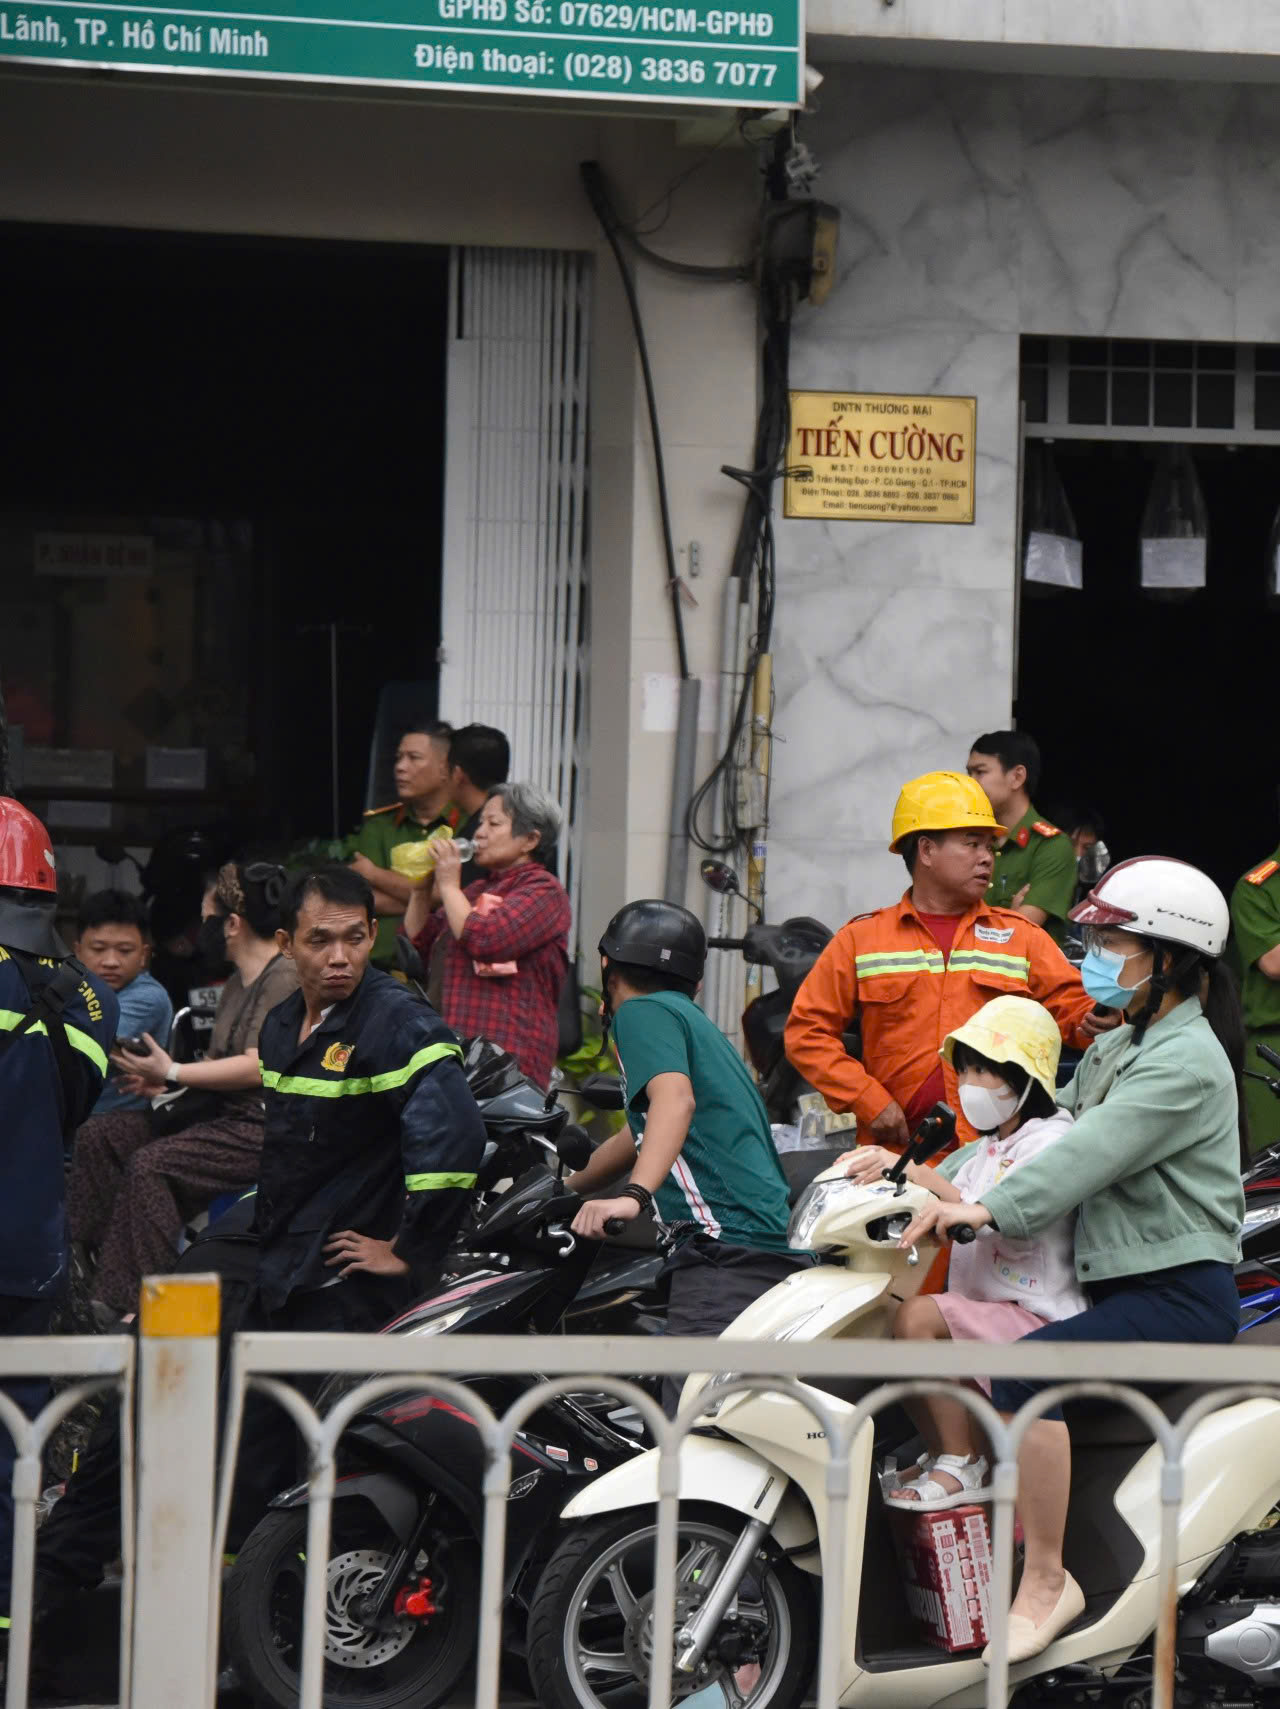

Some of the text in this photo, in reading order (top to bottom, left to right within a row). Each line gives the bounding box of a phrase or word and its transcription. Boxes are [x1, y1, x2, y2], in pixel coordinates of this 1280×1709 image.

[1, 13, 268, 56] Lãnh, TP. Hồ Chí Minh
[560, 2, 773, 37] 07629/HCM-GPHĐ
[414, 44, 777, 87] Điện thoại: (028) 3836 7077
[832, 402, 861, 413] DNTN
[797, 415, 965, 463] TIẾN CƯỜNG
